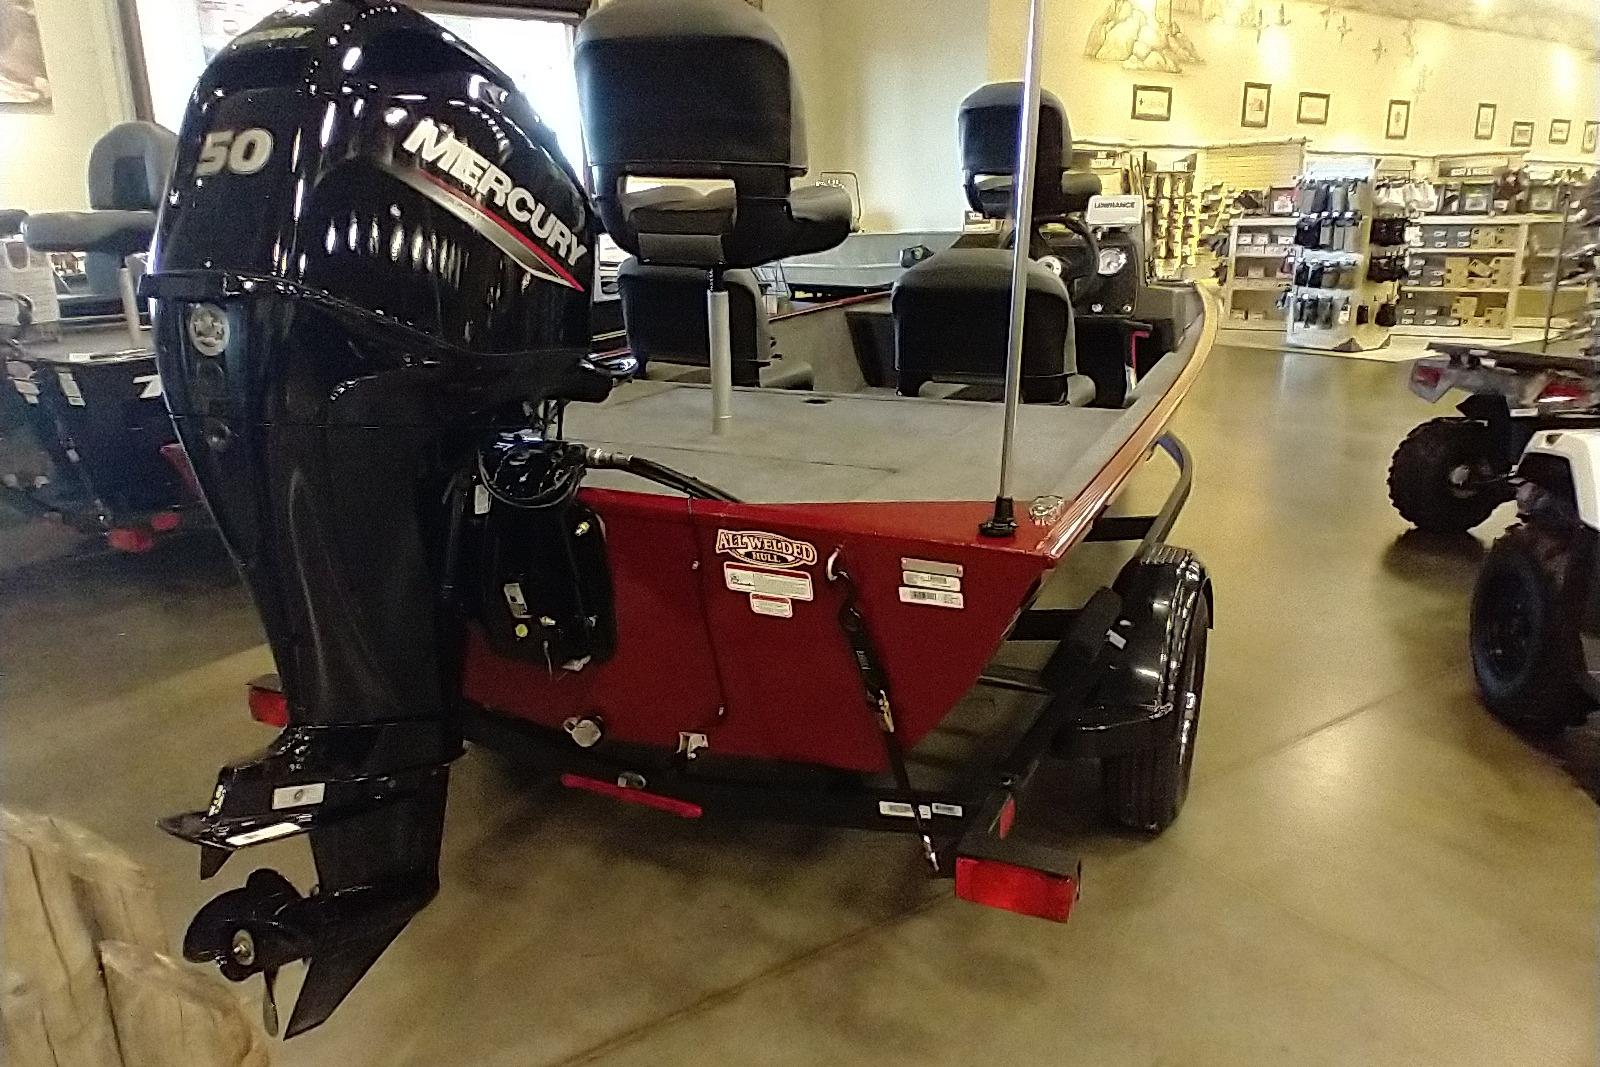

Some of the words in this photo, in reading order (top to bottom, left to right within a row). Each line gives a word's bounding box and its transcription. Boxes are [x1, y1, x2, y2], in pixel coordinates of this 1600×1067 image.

[196, 127, 274, 176] 50
[403, 117, 587, 265] MERCURY
[1094, 201, 1136, 209] LOWRANCE
[719, 533, 746, 548] ALL
[746, 536, 814, 561] WELDED
[753, 551, 779, 562] HULL
